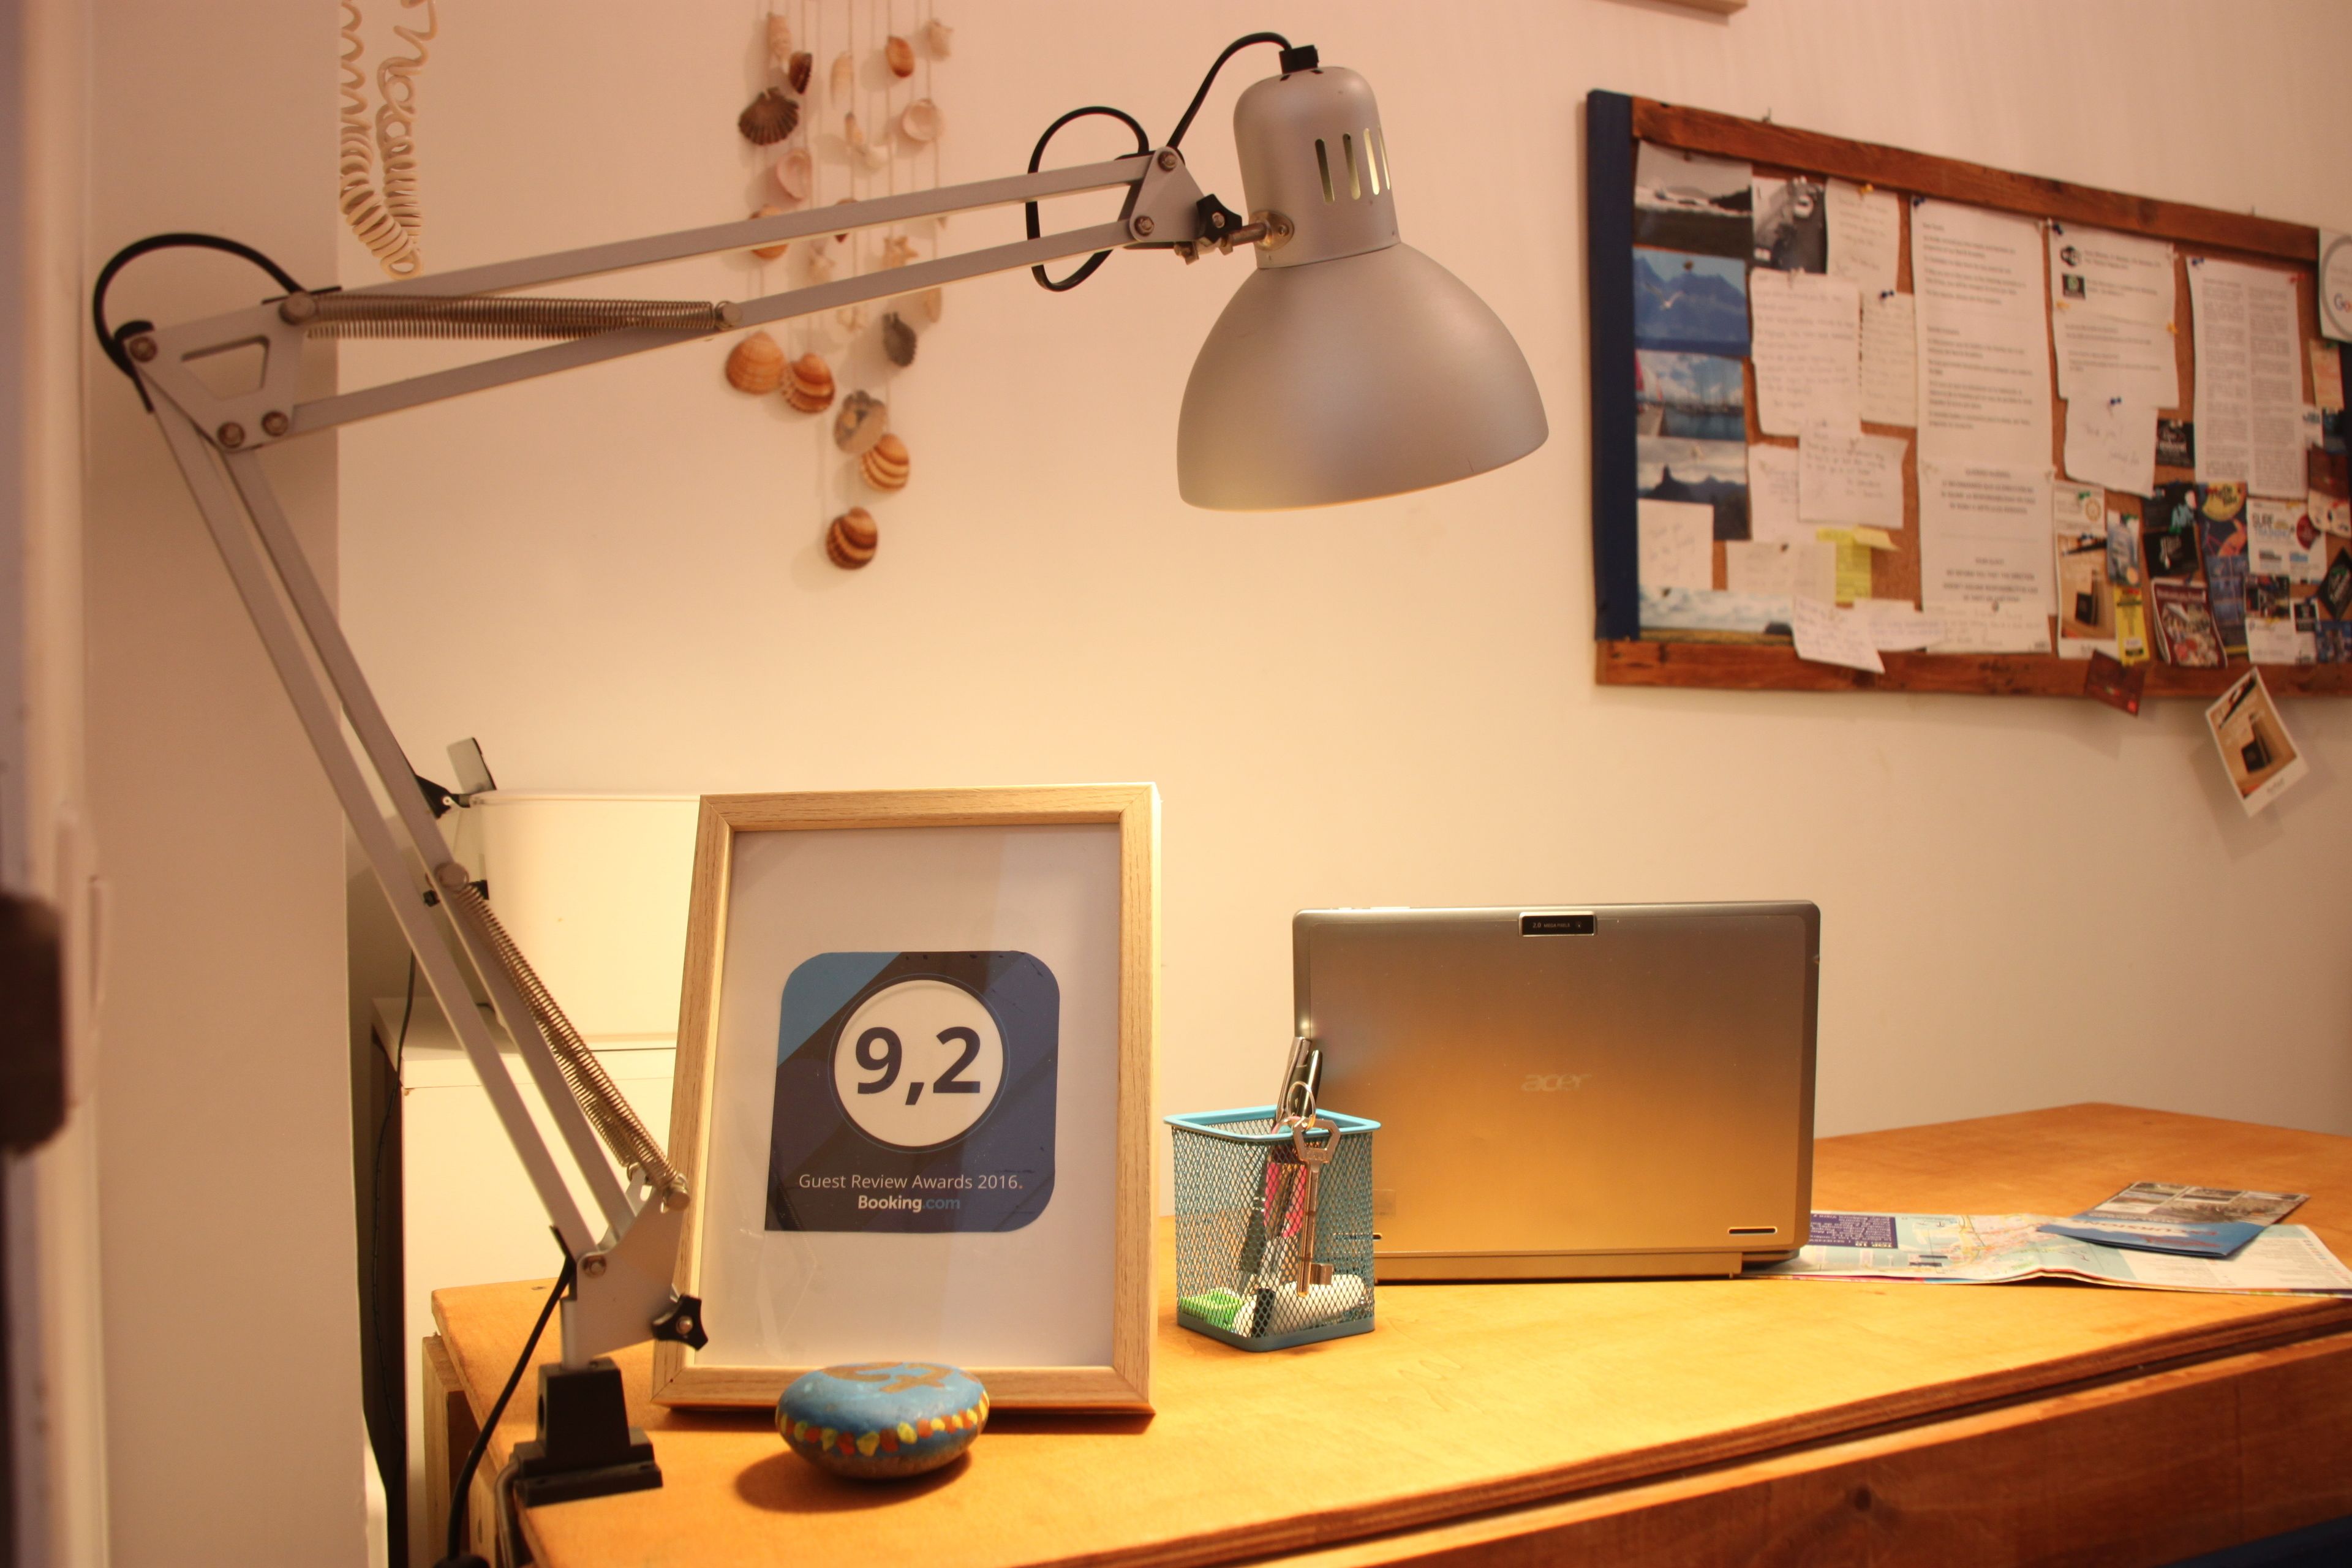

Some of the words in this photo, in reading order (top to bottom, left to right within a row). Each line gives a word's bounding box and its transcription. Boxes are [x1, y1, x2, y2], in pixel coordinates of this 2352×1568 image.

[856, 1027, 980, 1105] 9,2
[1521, 1073, 1593, 1091] acer
[799, 1174, 846, 1188] Guest
[852, 1175, 907, 1188] Review
[912, 1175, 973, 1189] Awards
[858, 1195, 960, 1213] Booking.com
